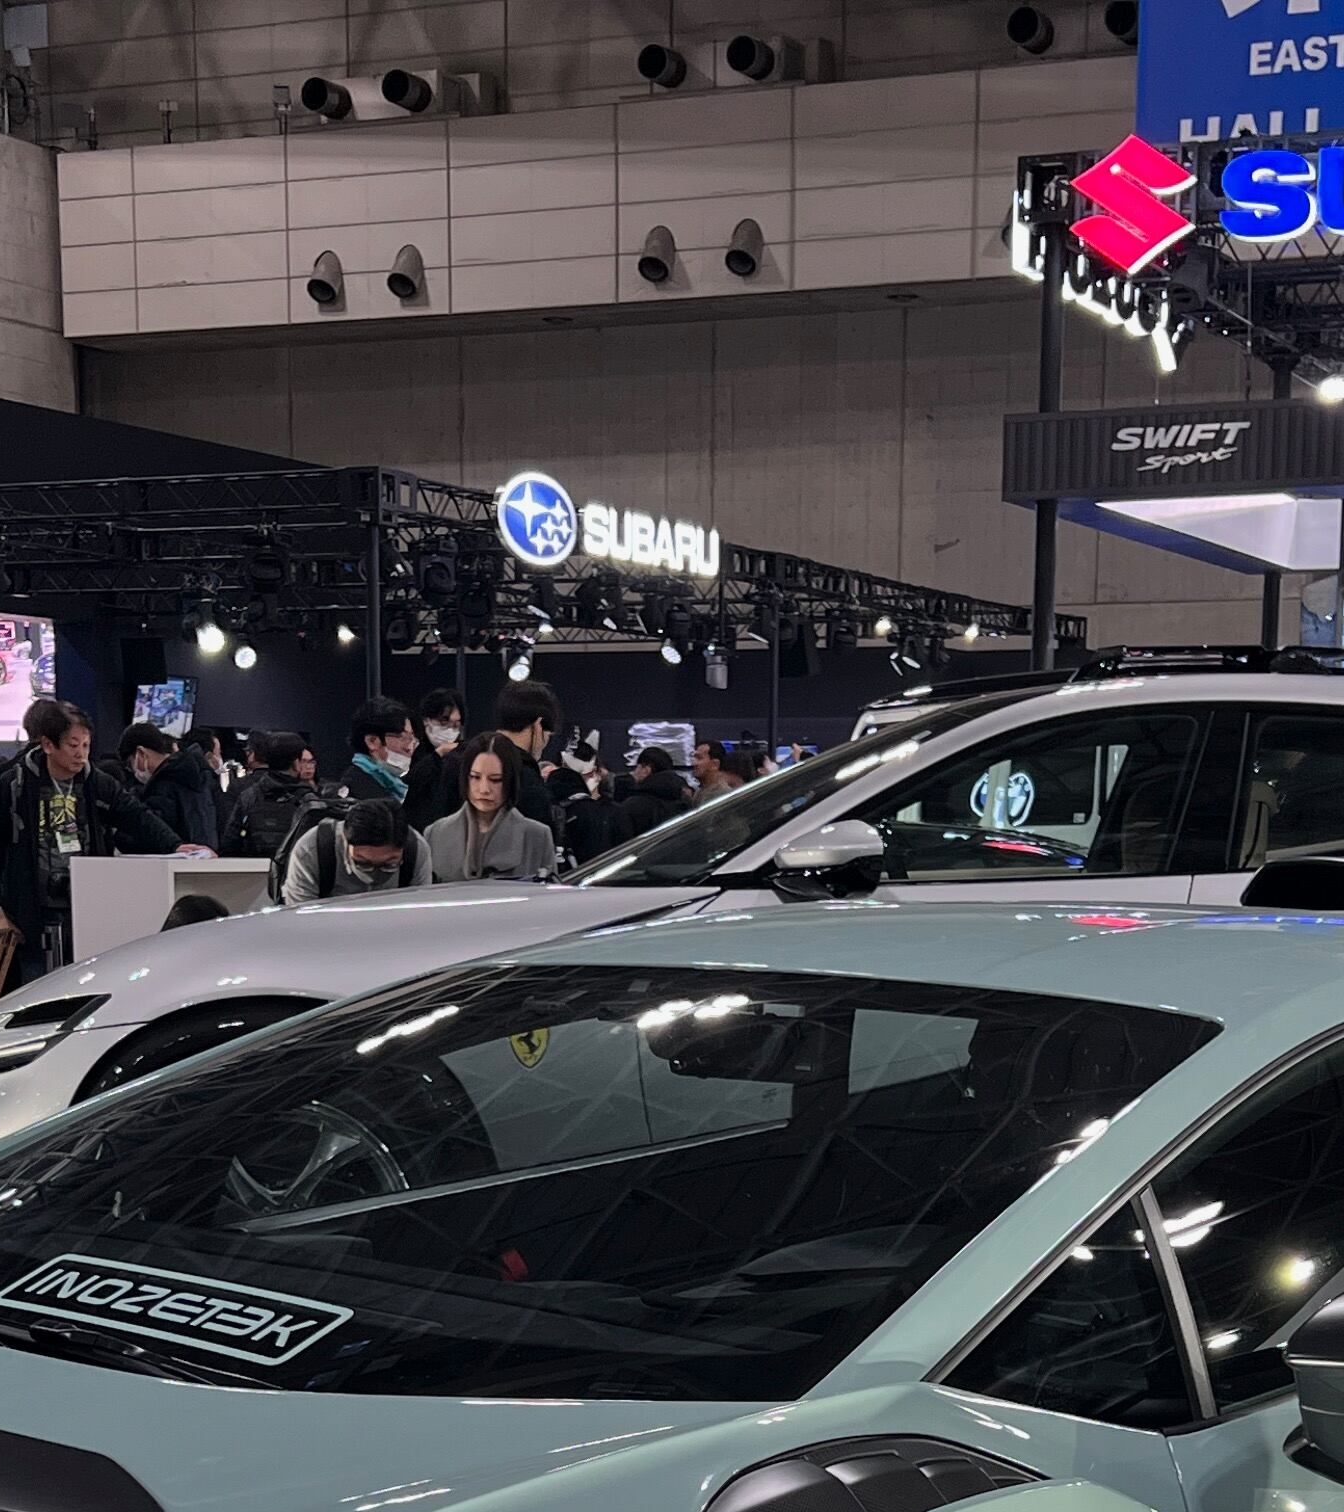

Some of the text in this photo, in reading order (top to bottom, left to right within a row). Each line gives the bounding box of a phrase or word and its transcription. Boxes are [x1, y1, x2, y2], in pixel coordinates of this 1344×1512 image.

[1111, 421, 1251, 450] SWIFT
[1135, 446, 1238, 474] Sport
[582, 502, 720, 577] SUBARU
